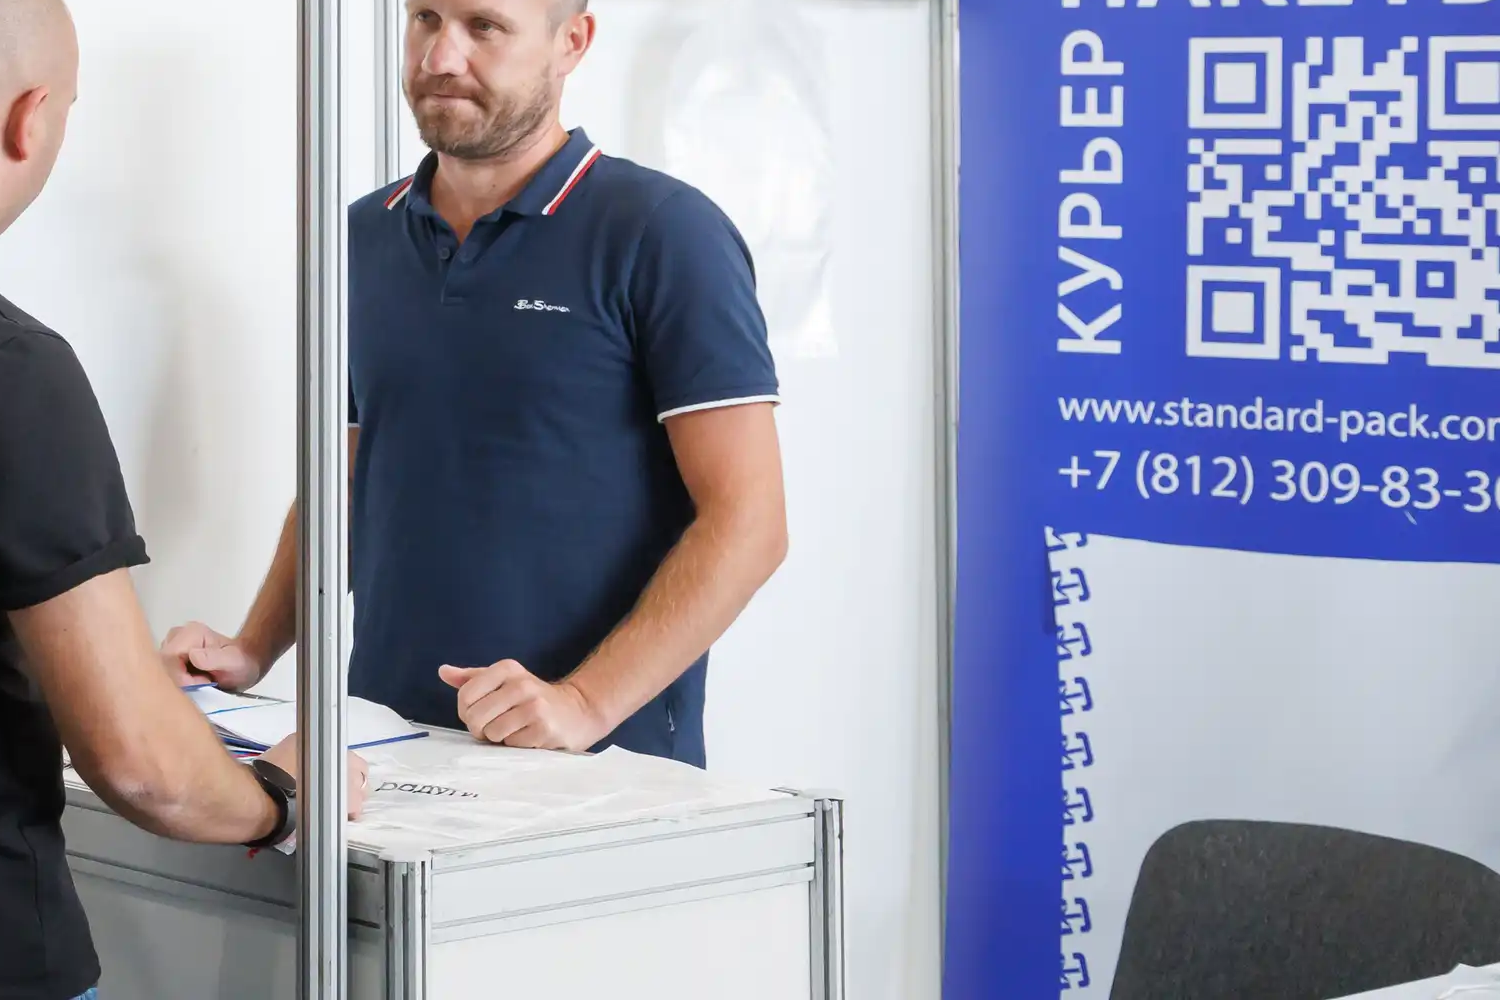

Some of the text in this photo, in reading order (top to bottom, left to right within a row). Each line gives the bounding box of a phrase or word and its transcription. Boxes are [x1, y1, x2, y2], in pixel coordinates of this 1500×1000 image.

[1057, 29, 1124, 355] КУРЬЕР
[1058, 449, 1500, 513] +7 (812) 309-83-3
